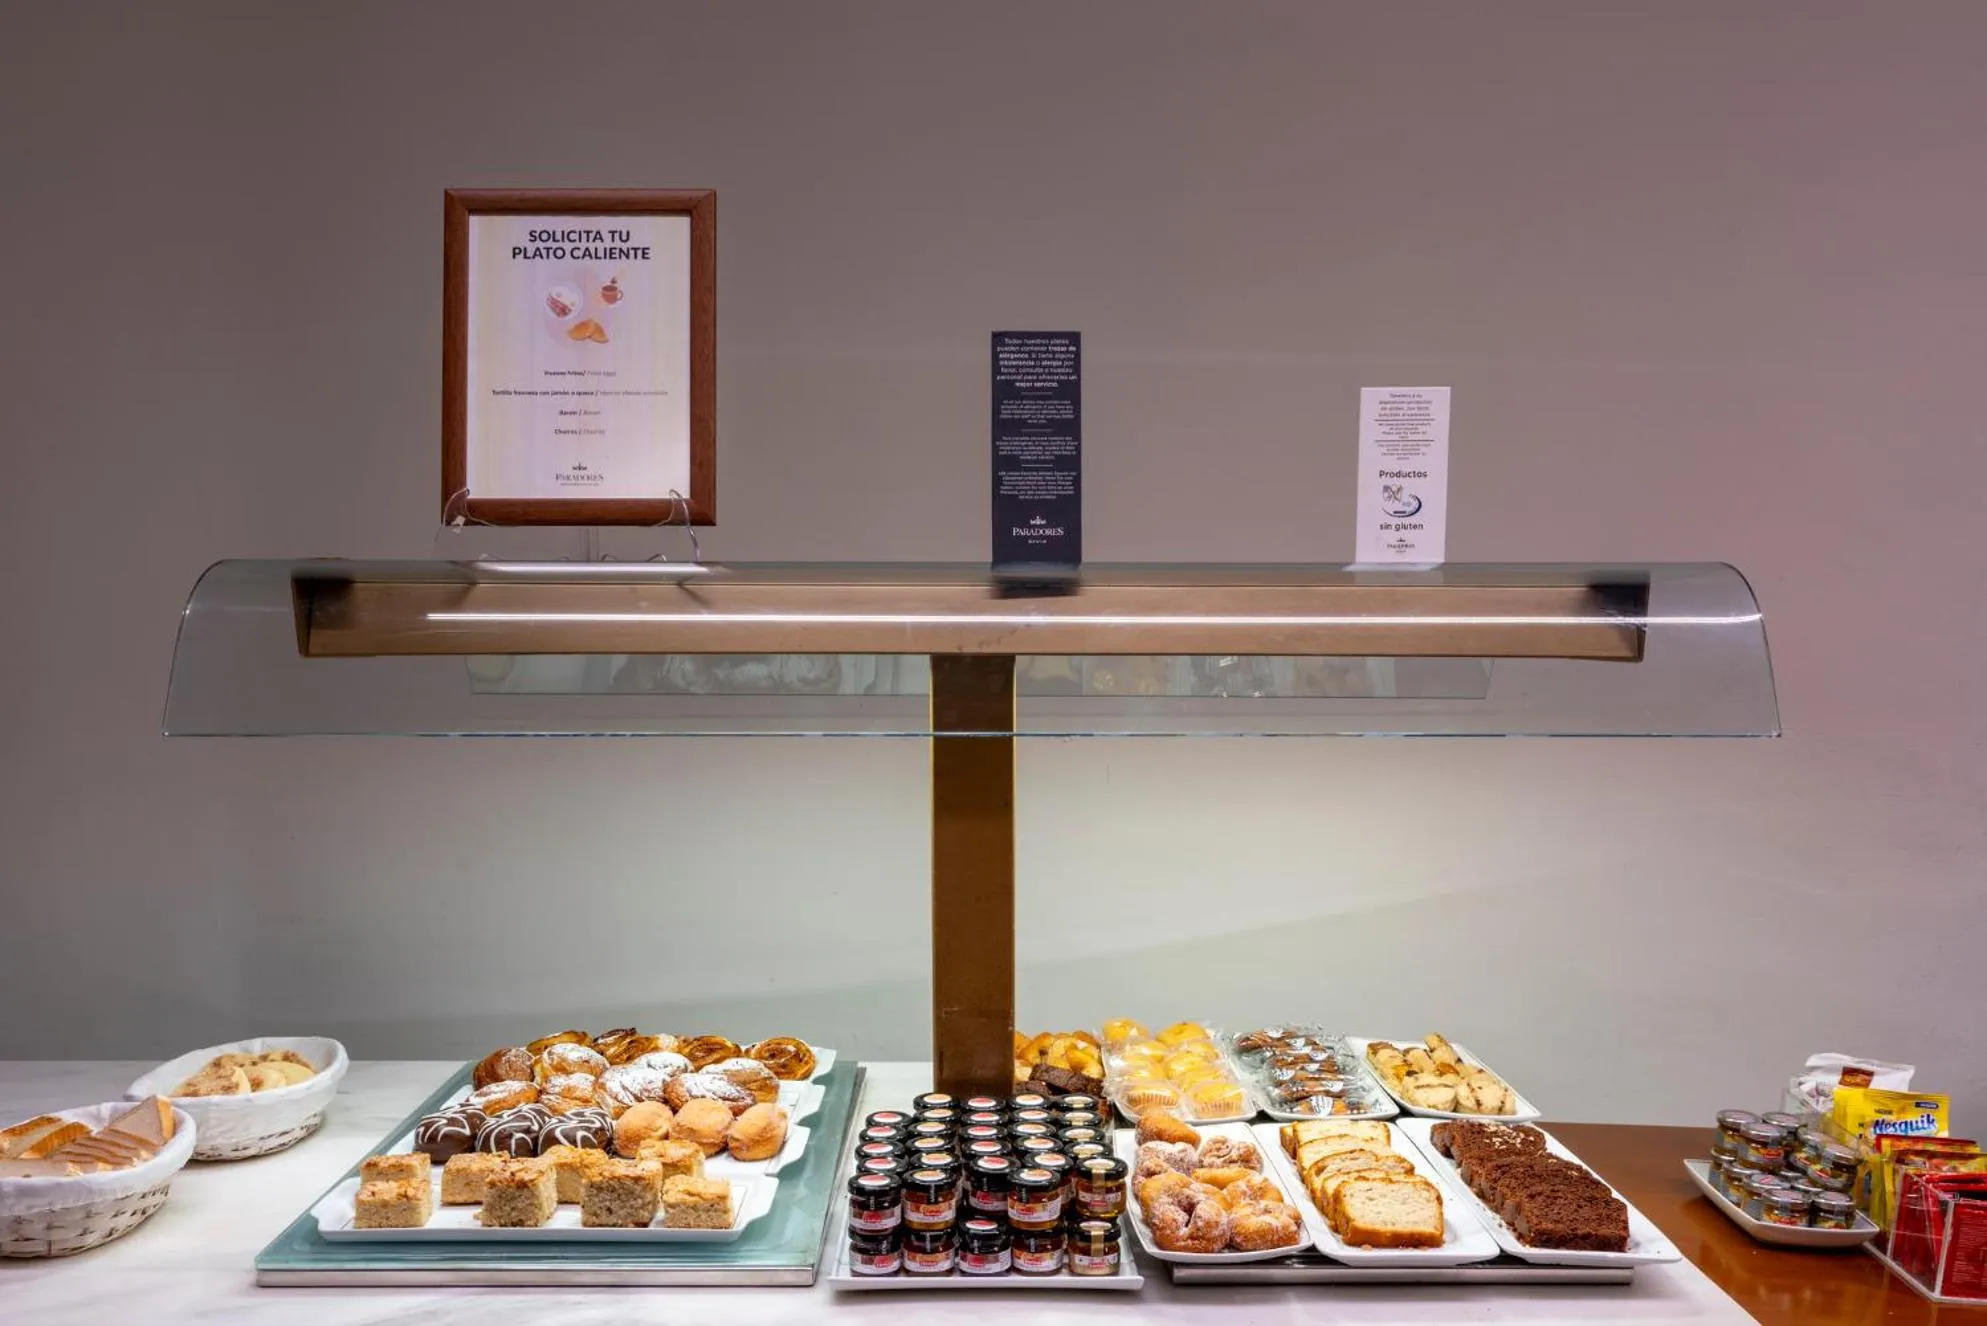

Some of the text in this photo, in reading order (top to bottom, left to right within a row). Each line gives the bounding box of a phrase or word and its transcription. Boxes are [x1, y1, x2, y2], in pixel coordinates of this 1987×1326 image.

[528, 230, 630, 243] SOLICITA TU
[512, 247, 650, 260] PLATO CALIENTE
[1379, 470, 1427, 478] Productos
[1012, 527, 1065, 536] PARADORES
[1379, 521, 1424, 532] sin gluten
[1873, 1113, 1935, 1136] Nesquik
